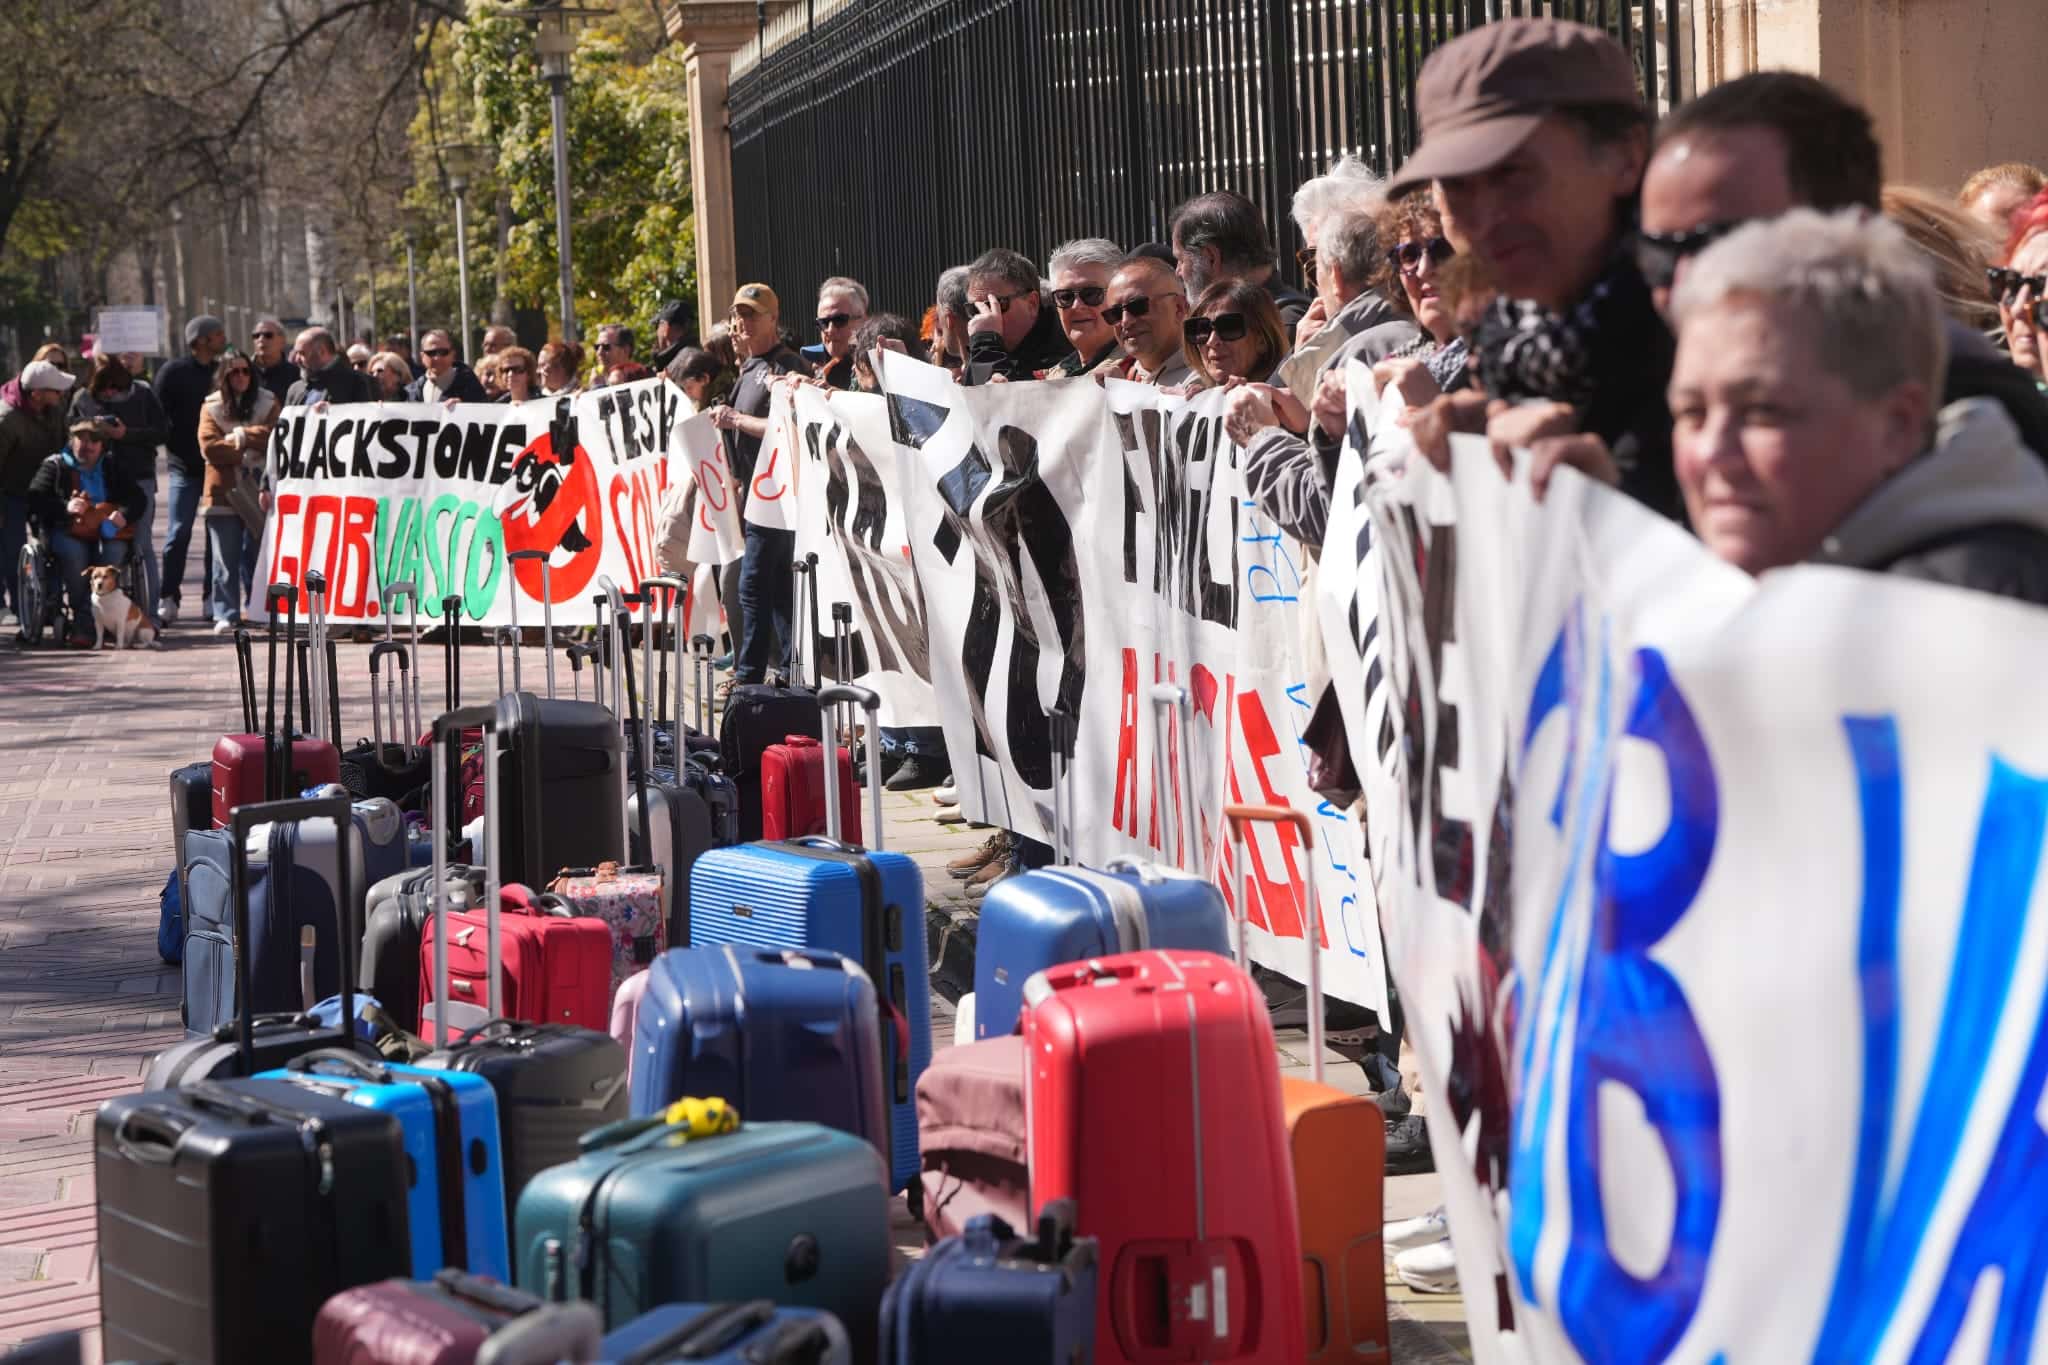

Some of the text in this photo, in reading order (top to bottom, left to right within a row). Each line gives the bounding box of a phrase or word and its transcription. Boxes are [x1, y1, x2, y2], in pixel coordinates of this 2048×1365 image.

[274, 414, 527, 485] BLACKSTONE
[265, 494, 503, 621] GOB. VASCO
